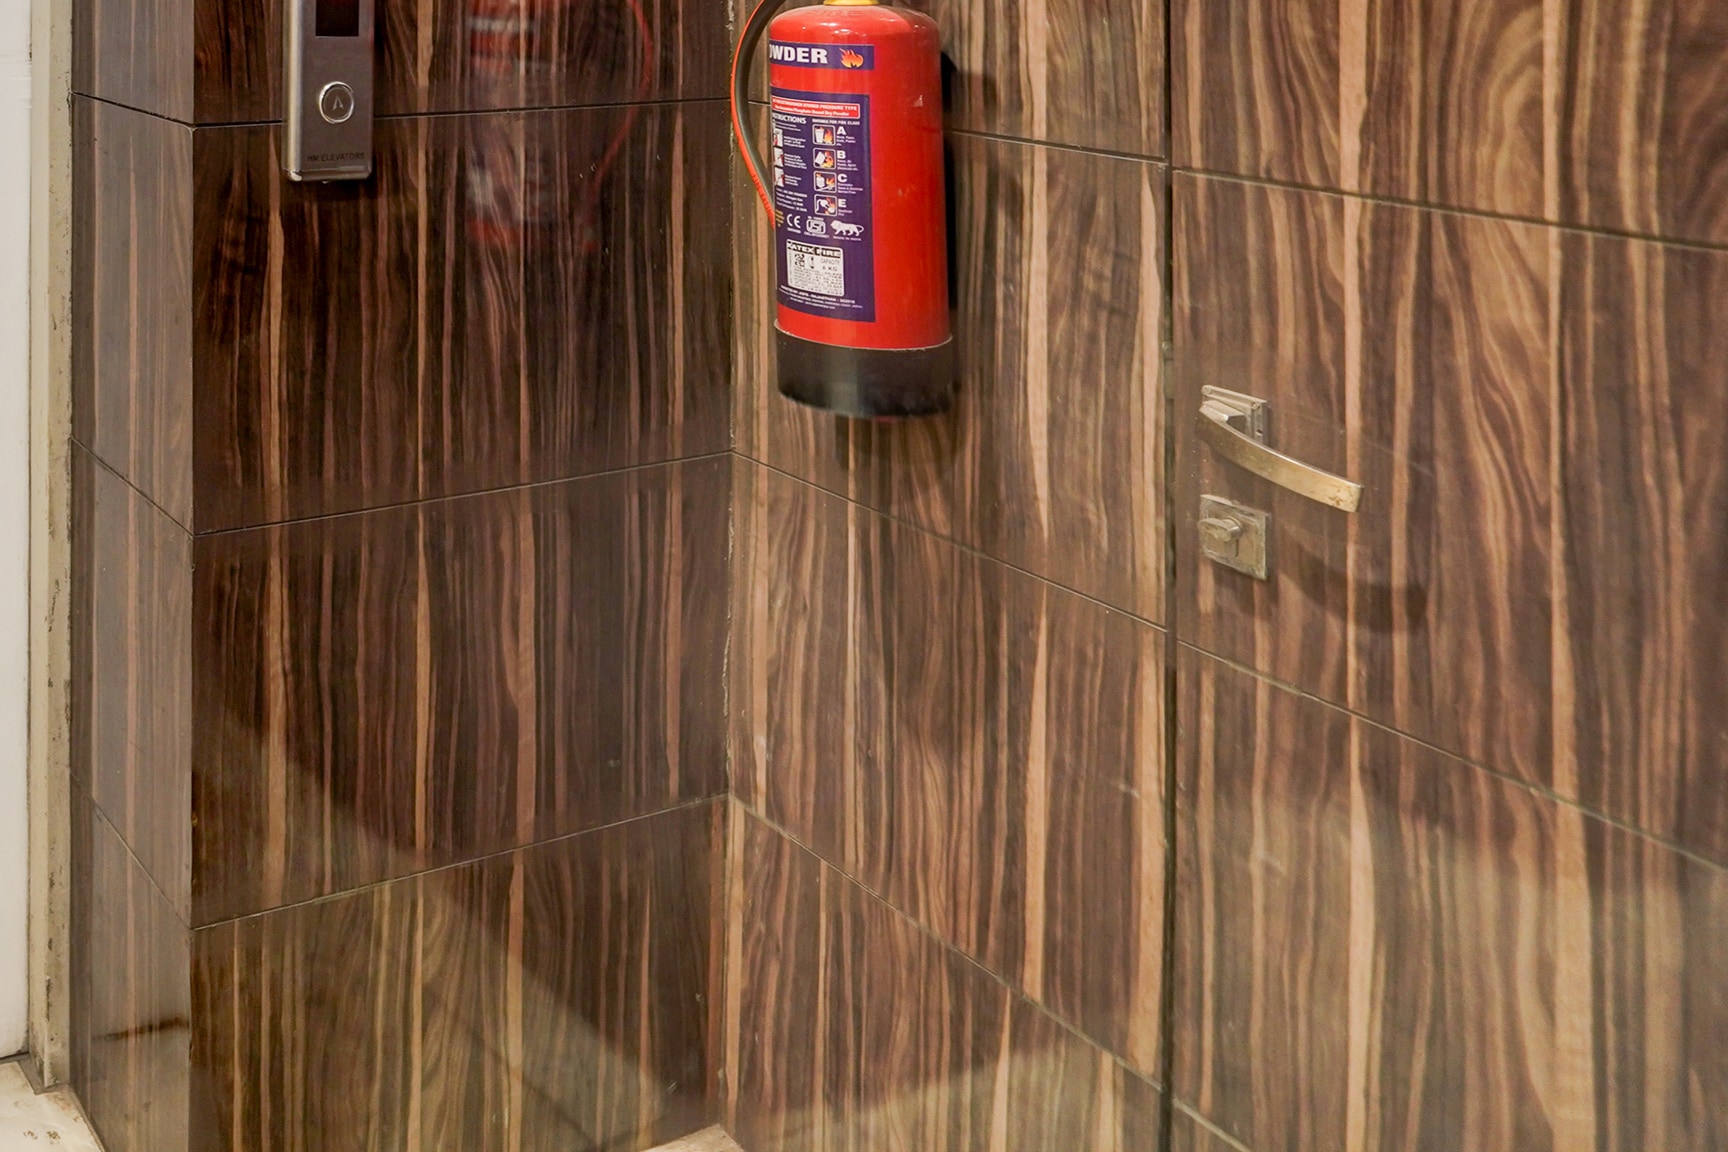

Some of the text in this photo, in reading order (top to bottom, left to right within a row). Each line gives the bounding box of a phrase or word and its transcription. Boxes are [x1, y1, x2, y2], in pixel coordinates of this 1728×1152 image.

[837, 126, 847, 136] A
[321, 152, 365, 162] ELEVATORS
[837, 150, 846, 159] B
[837, 173, 848, 183] C
[838, 199, 847, 208] E
[786, 213, 801, 229] CE
